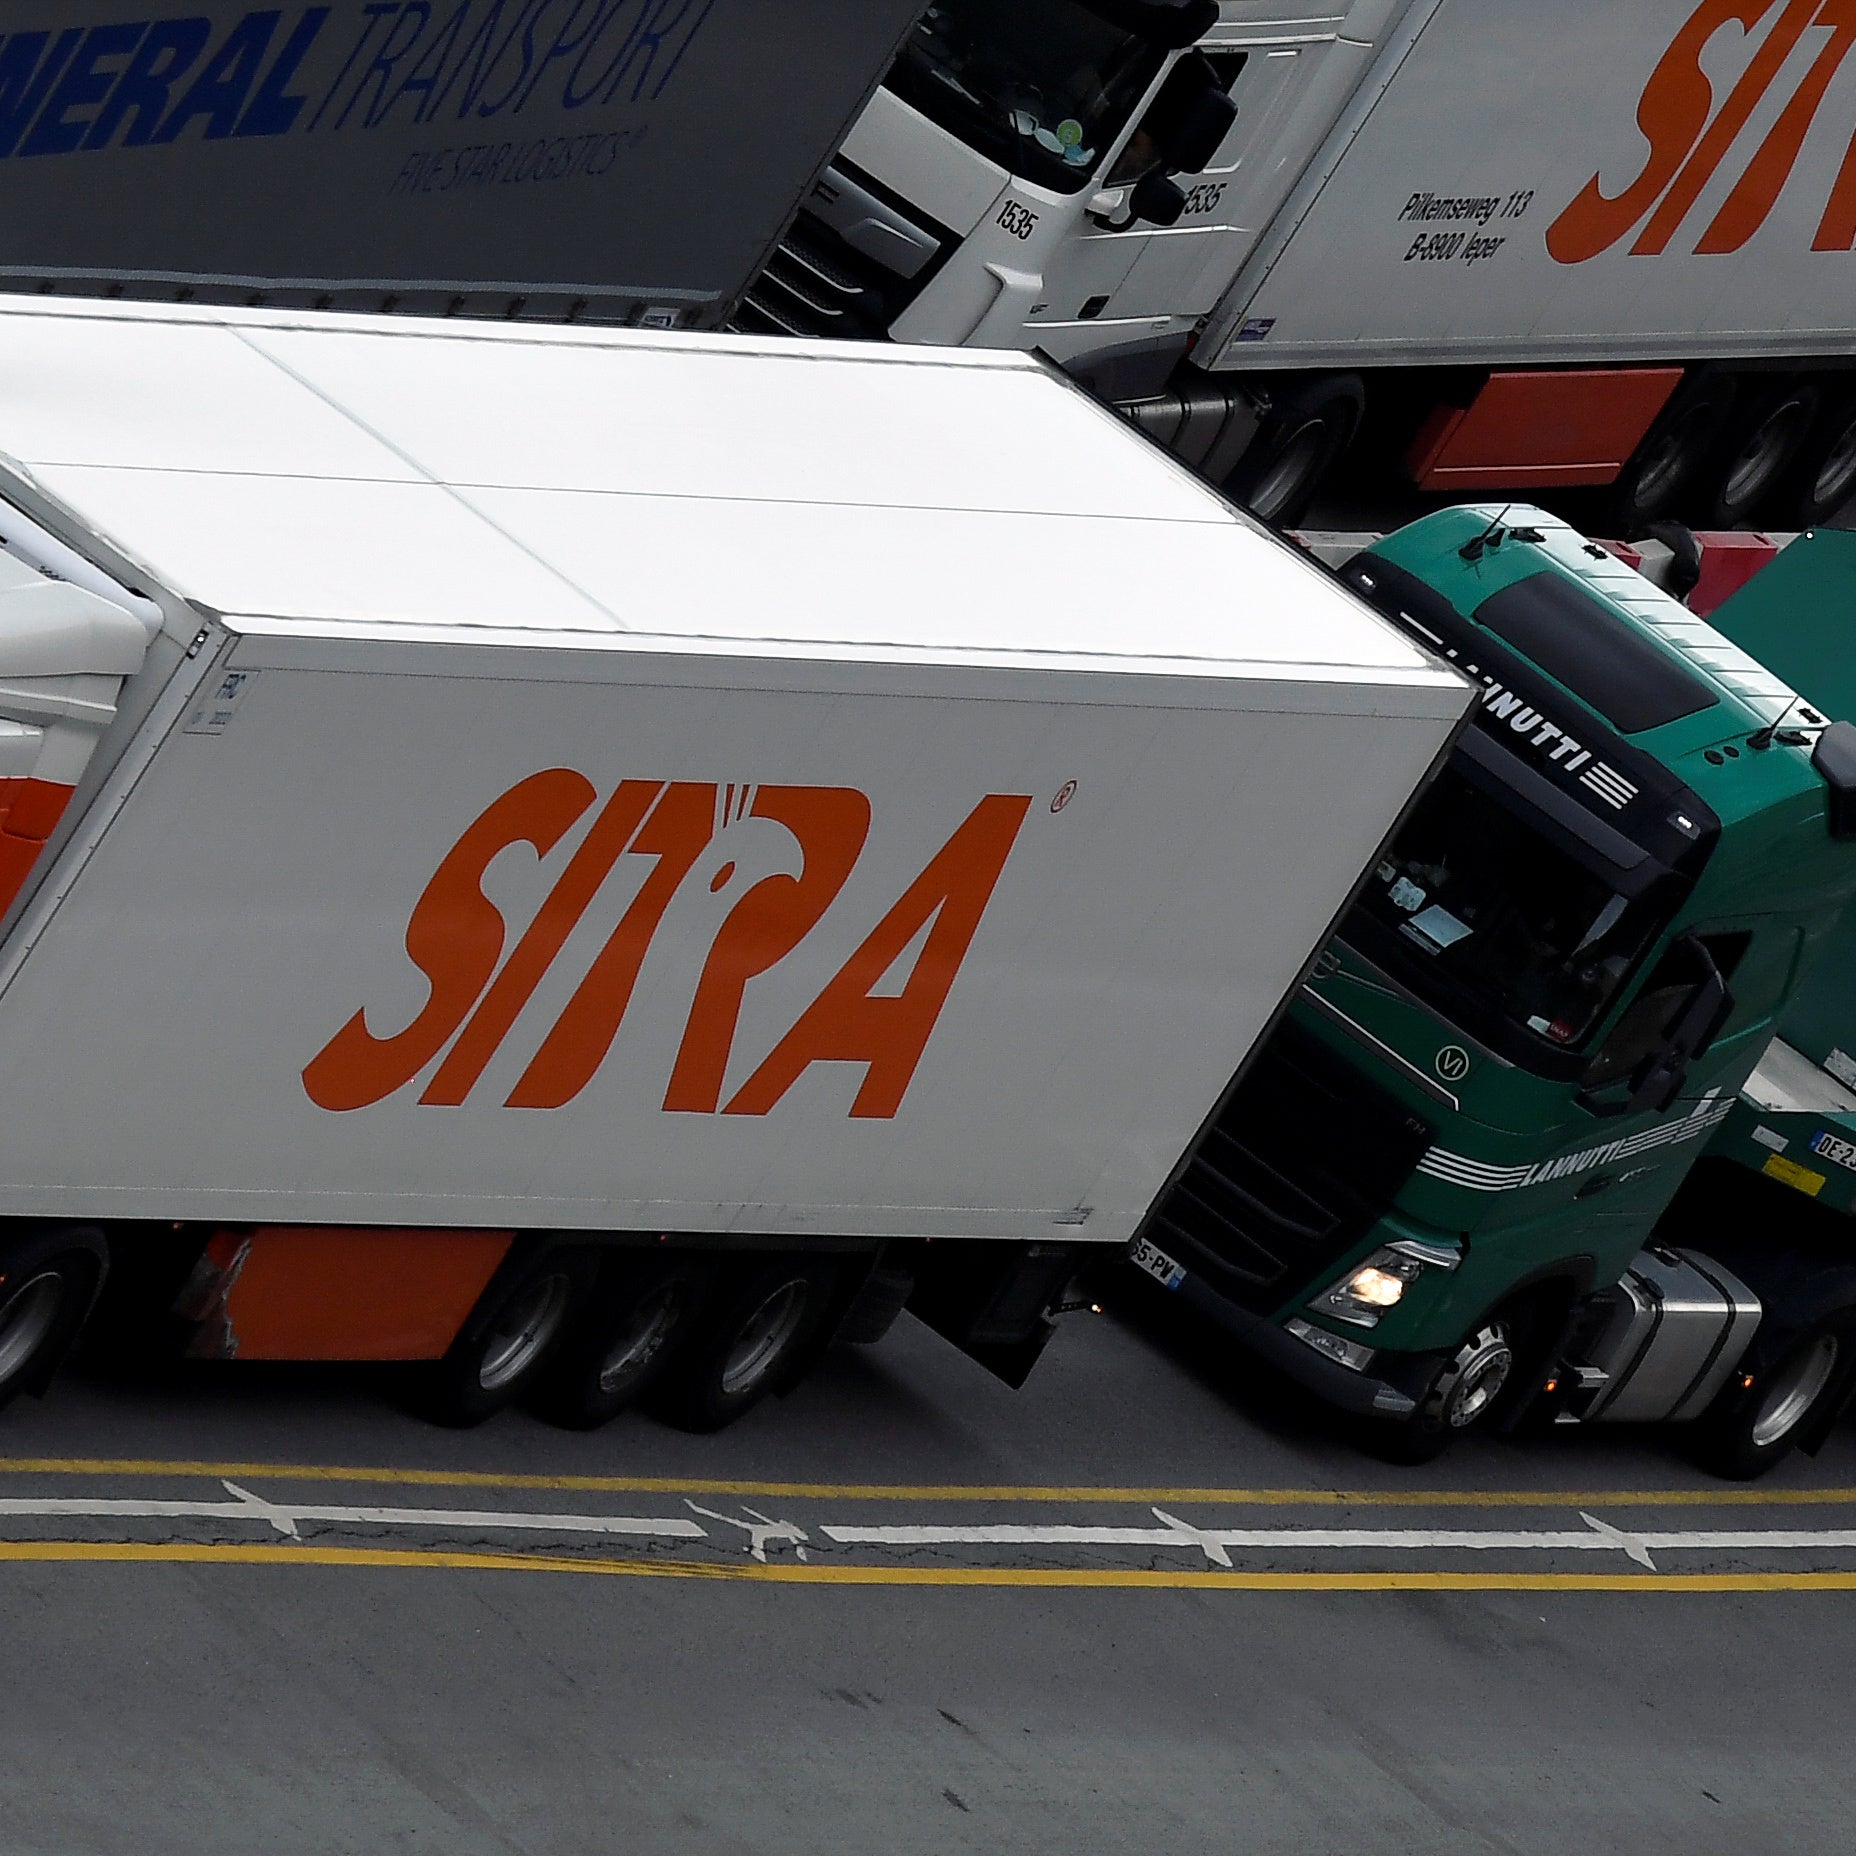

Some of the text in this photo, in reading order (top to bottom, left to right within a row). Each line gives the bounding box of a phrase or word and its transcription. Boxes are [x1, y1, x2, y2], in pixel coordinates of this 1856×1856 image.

[1184, 182, 1228, 215] 1535
[1397, 190, 1535, 227] Pilkemseweg 113
[996, 199, 1040, 241] 1535
[1403, 232, 1466, 261] B-8900
[300, 767, 1033, 1119] SITRA
[1520, 1136, 1627, 1188] LANNUTTI
